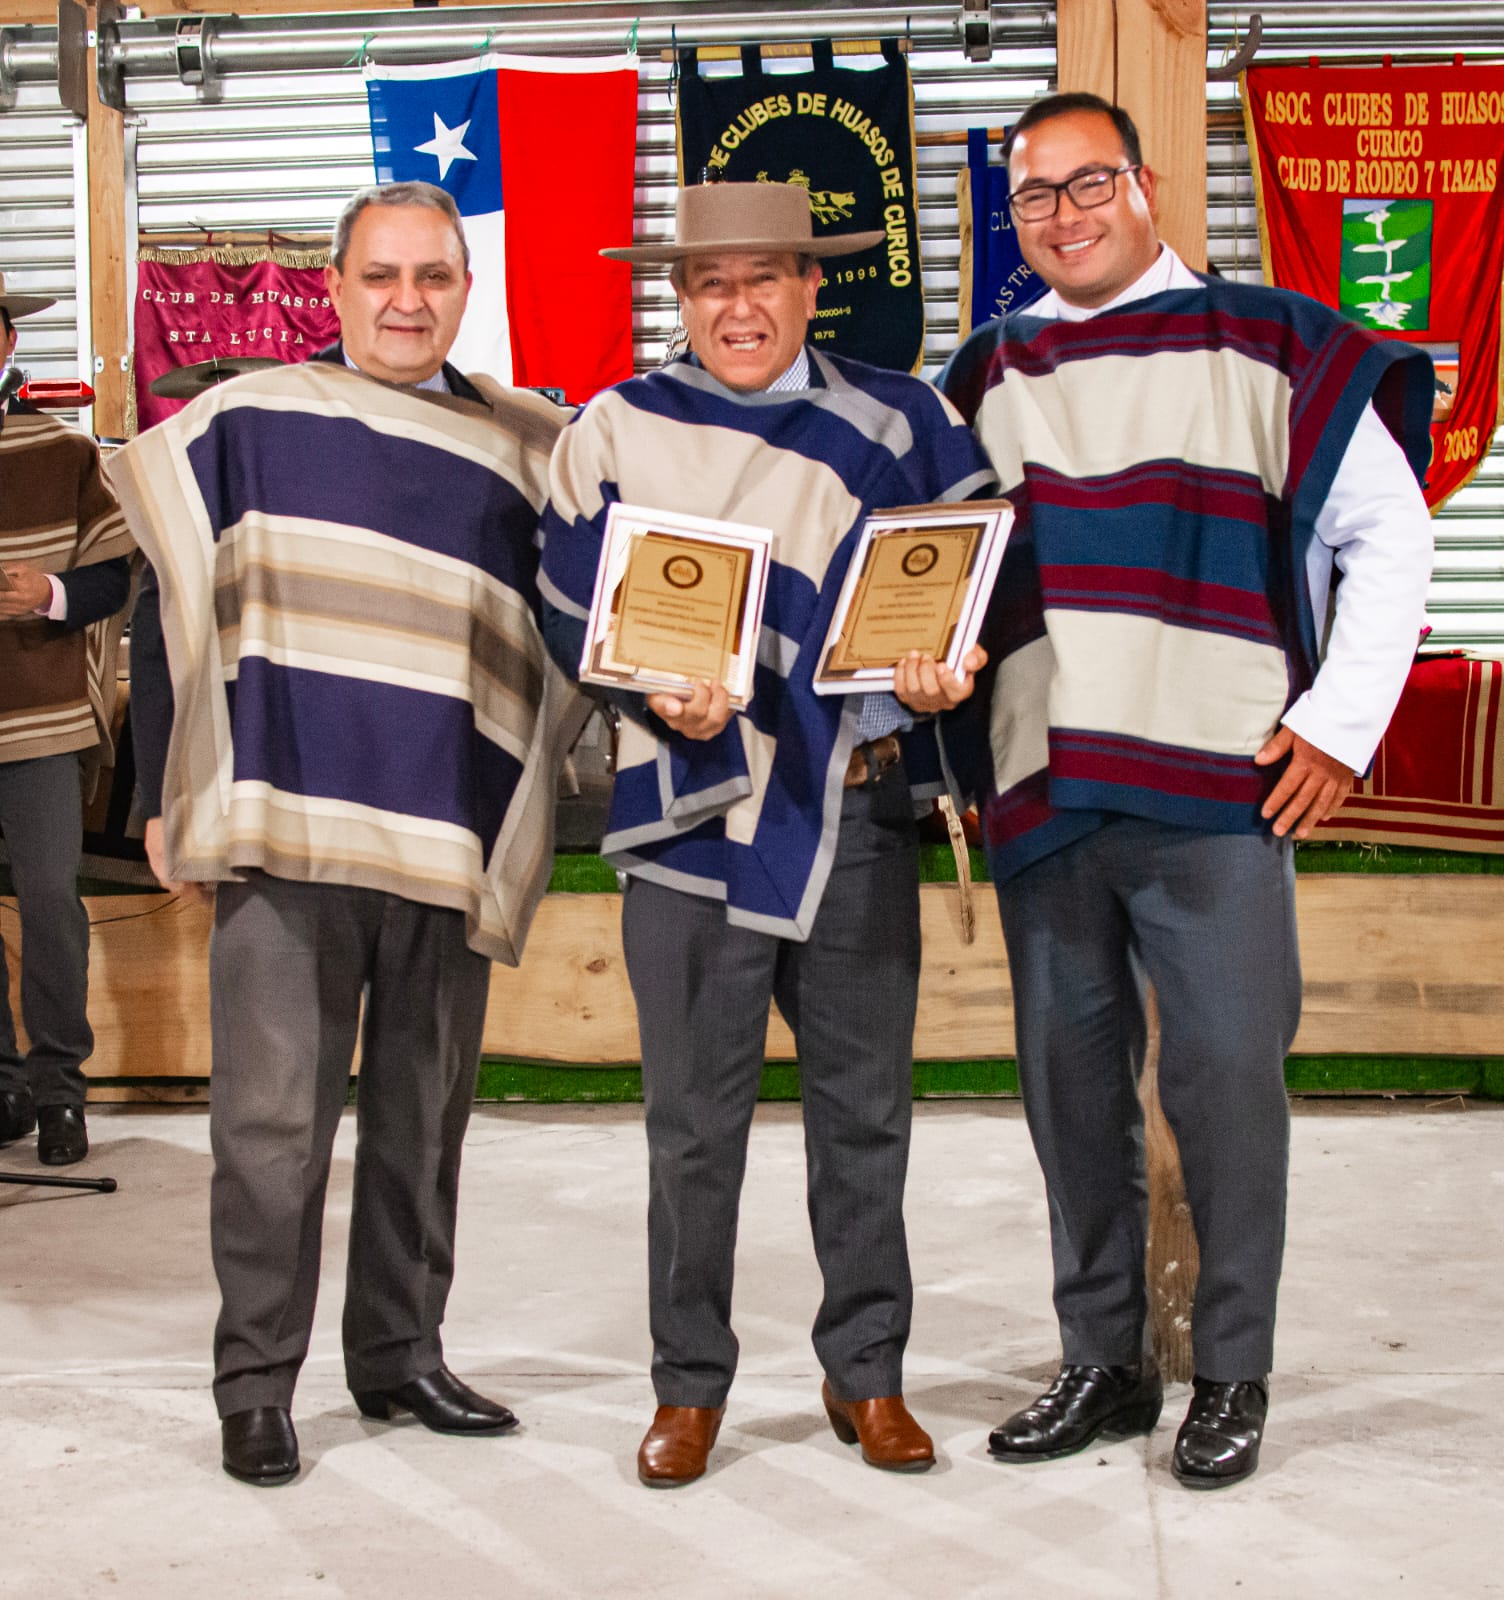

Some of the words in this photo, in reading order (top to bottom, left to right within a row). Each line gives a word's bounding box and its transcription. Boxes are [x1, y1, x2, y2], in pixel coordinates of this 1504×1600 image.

[797, 92, 828, 115] DE
[1323, 92, 1393, 126] CLUBES
[1404, 92, 1429, 126] DE
[720, 94, 792, 149] CLUBES
[830, 97, 894, 167] HUASOS
[1357, 129, 1423, 158] CURICO
[880, 167, 905, 199] DE
[1277, 155, 1321, 191] CLUB
[1326, 159, 1350, 193] DE
[1355, 160, 1418, 194] RODEO
[1424, 160, 1435, 193] 7
[1440, 159, 1496, 193] TAZAS
[991, 211, 1011, 231] CL
[883, 204, 912, 287] CURICO
[836, 266, 877, 284] 1998
[143, 289, 195, 304] CLUB
[210, 291, 234, 305] DE
[252, 290, 330, 308] HUASOS
[169, 330, 212, 343] STA
[230, 328, 304, 344] LUCIA
[1444, 426, 1478, 463] 2003
